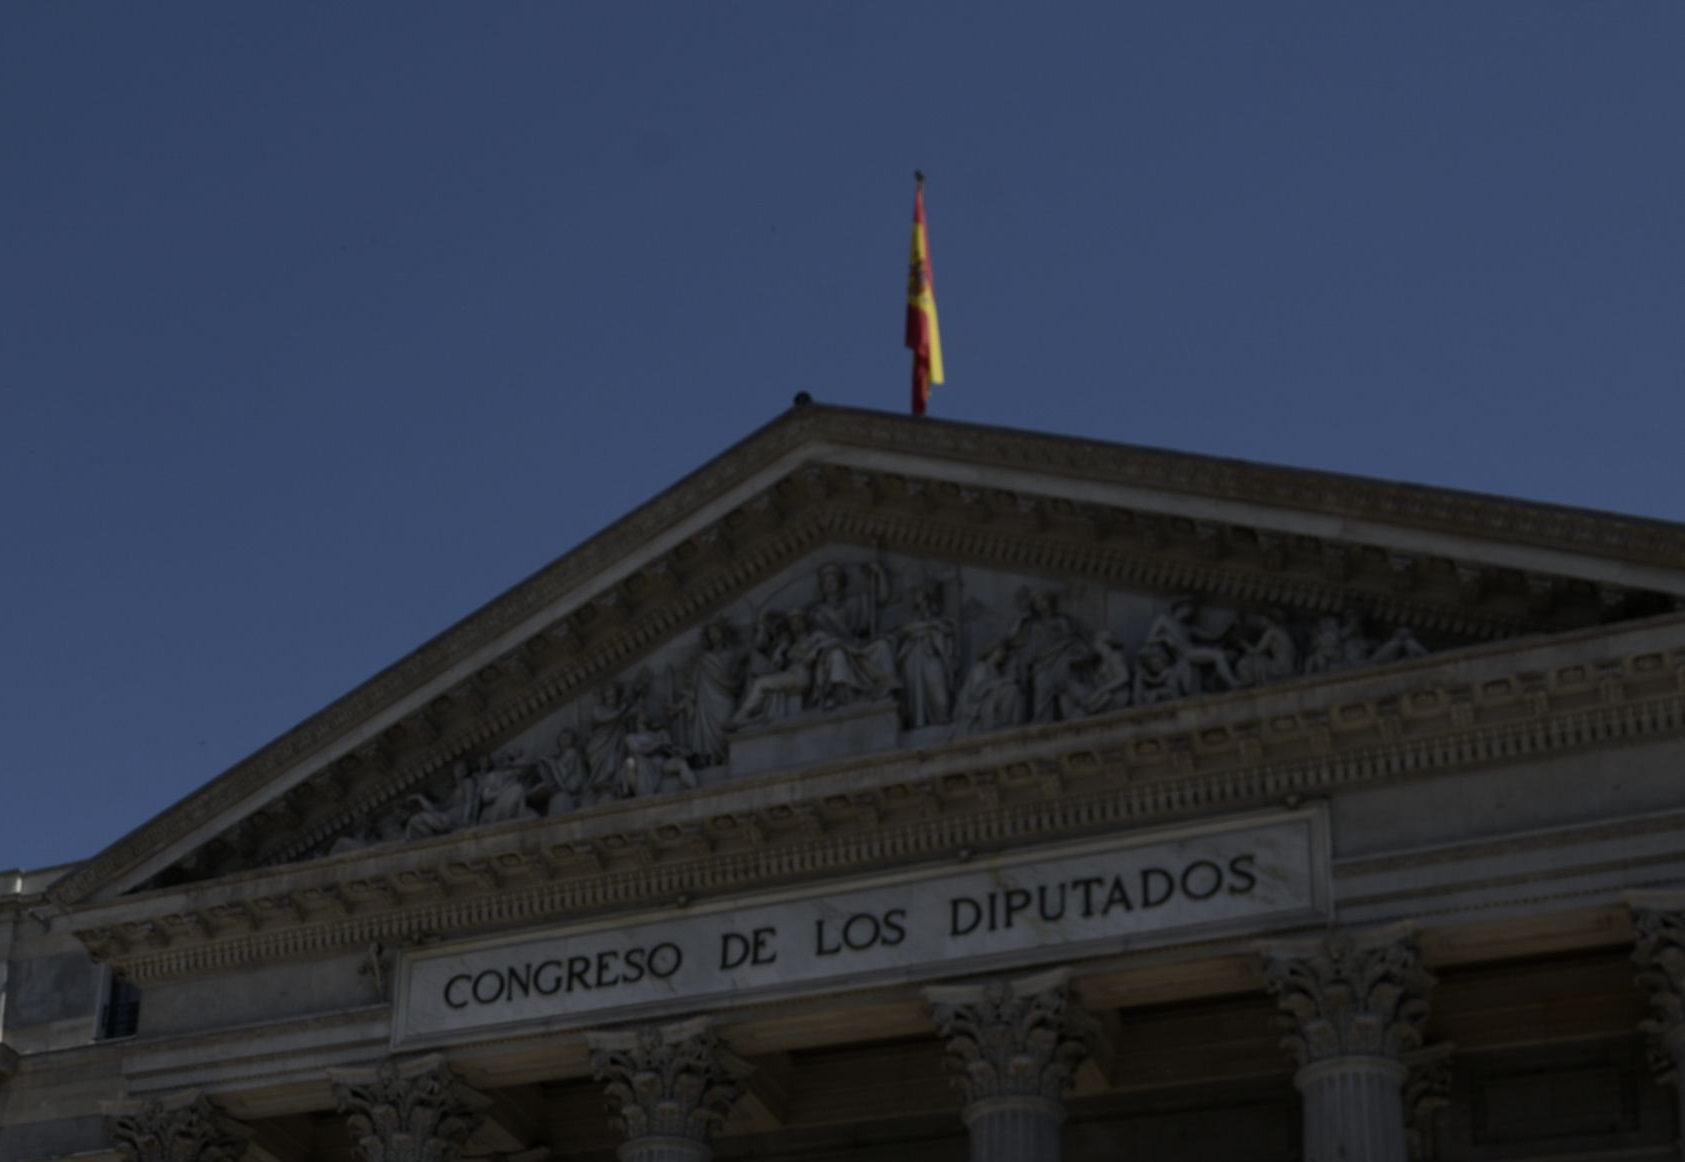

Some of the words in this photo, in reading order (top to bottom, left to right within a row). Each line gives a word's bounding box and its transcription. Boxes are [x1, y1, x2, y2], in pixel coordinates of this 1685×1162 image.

[443, 942, 683, 1009] CONGRESO
[720, 927, 777, 971] DE
[815, 909, 907, 956] LOS
[949, 855, 1257, 937] DIPUTADOS
